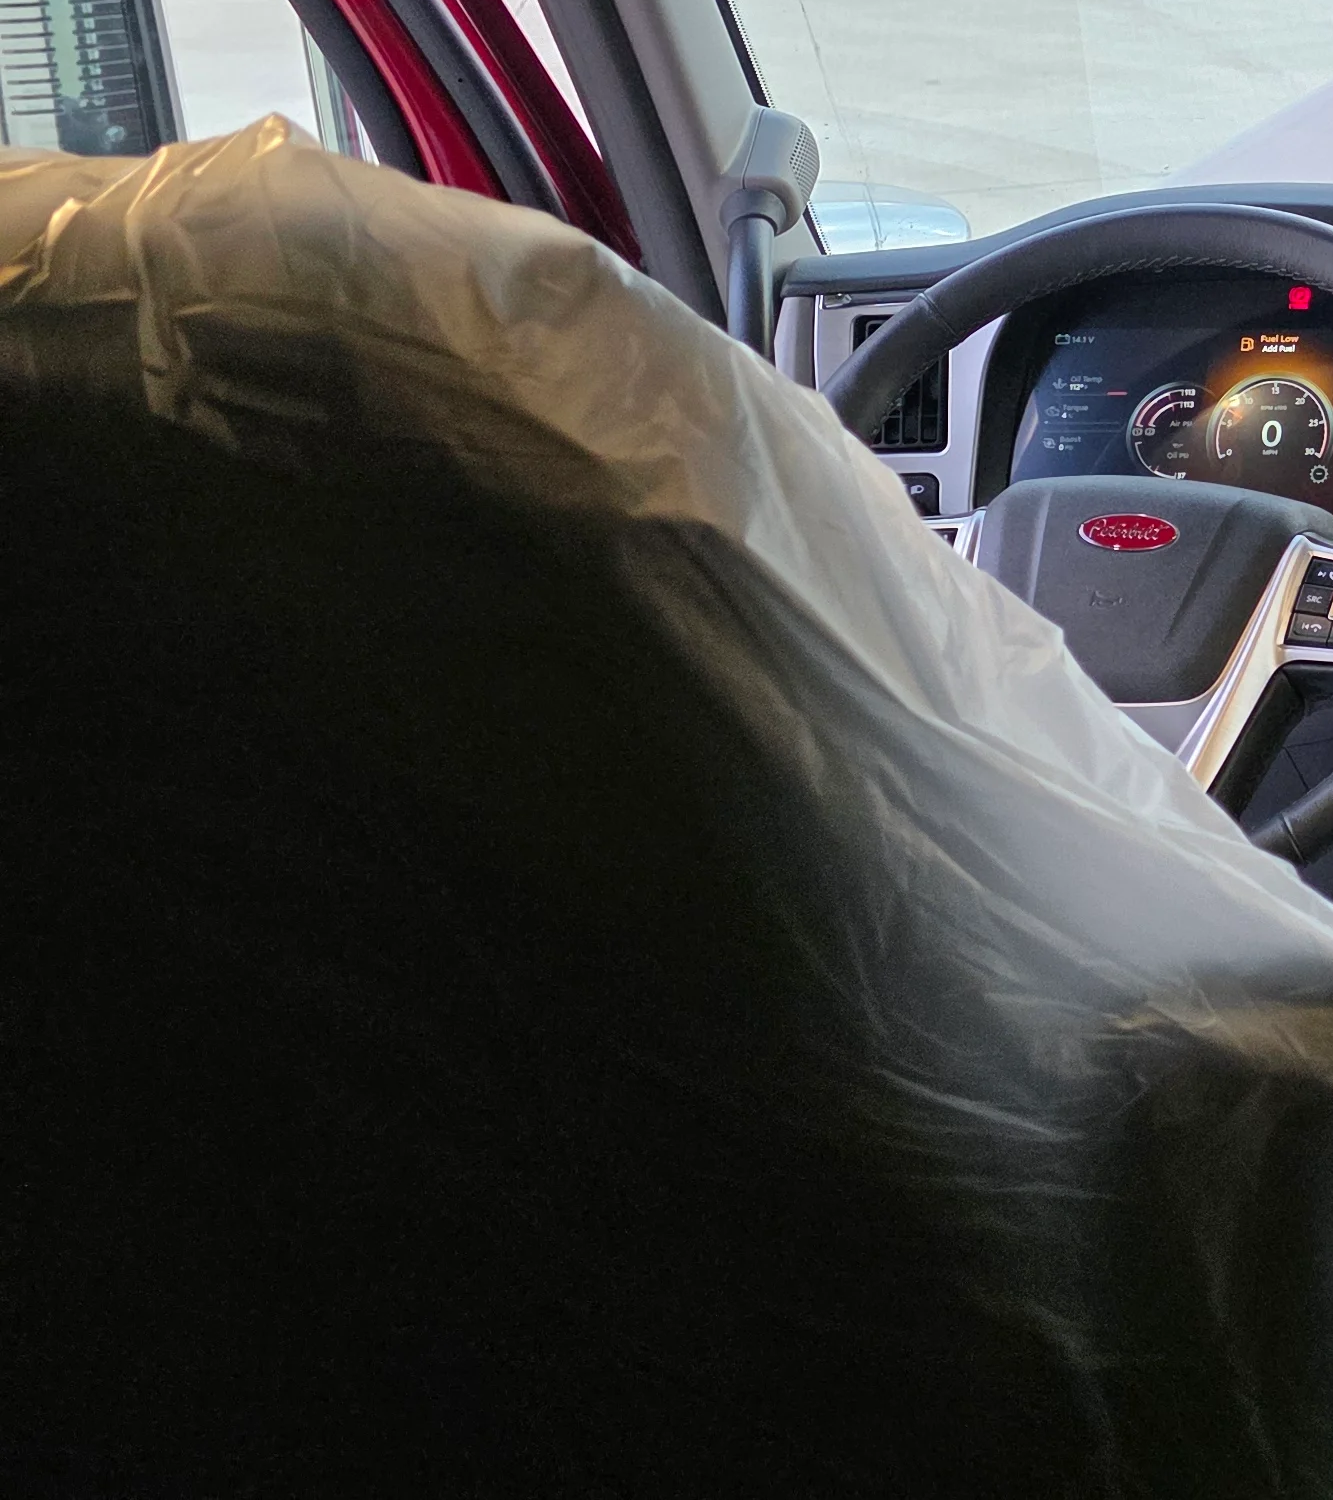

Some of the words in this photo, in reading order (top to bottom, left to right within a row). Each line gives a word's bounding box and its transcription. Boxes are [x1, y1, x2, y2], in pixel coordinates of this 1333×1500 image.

[1260, 334, 1279, 343] Fuel
[1280, 334, 1299, 343] Low
[1308, 418, 1318, 426] 25
[1262, 420, 1282, 448] 0
[1089, 519, 1162, 541] Peterbilt
[1306, 594, 1322, 604] SRC
